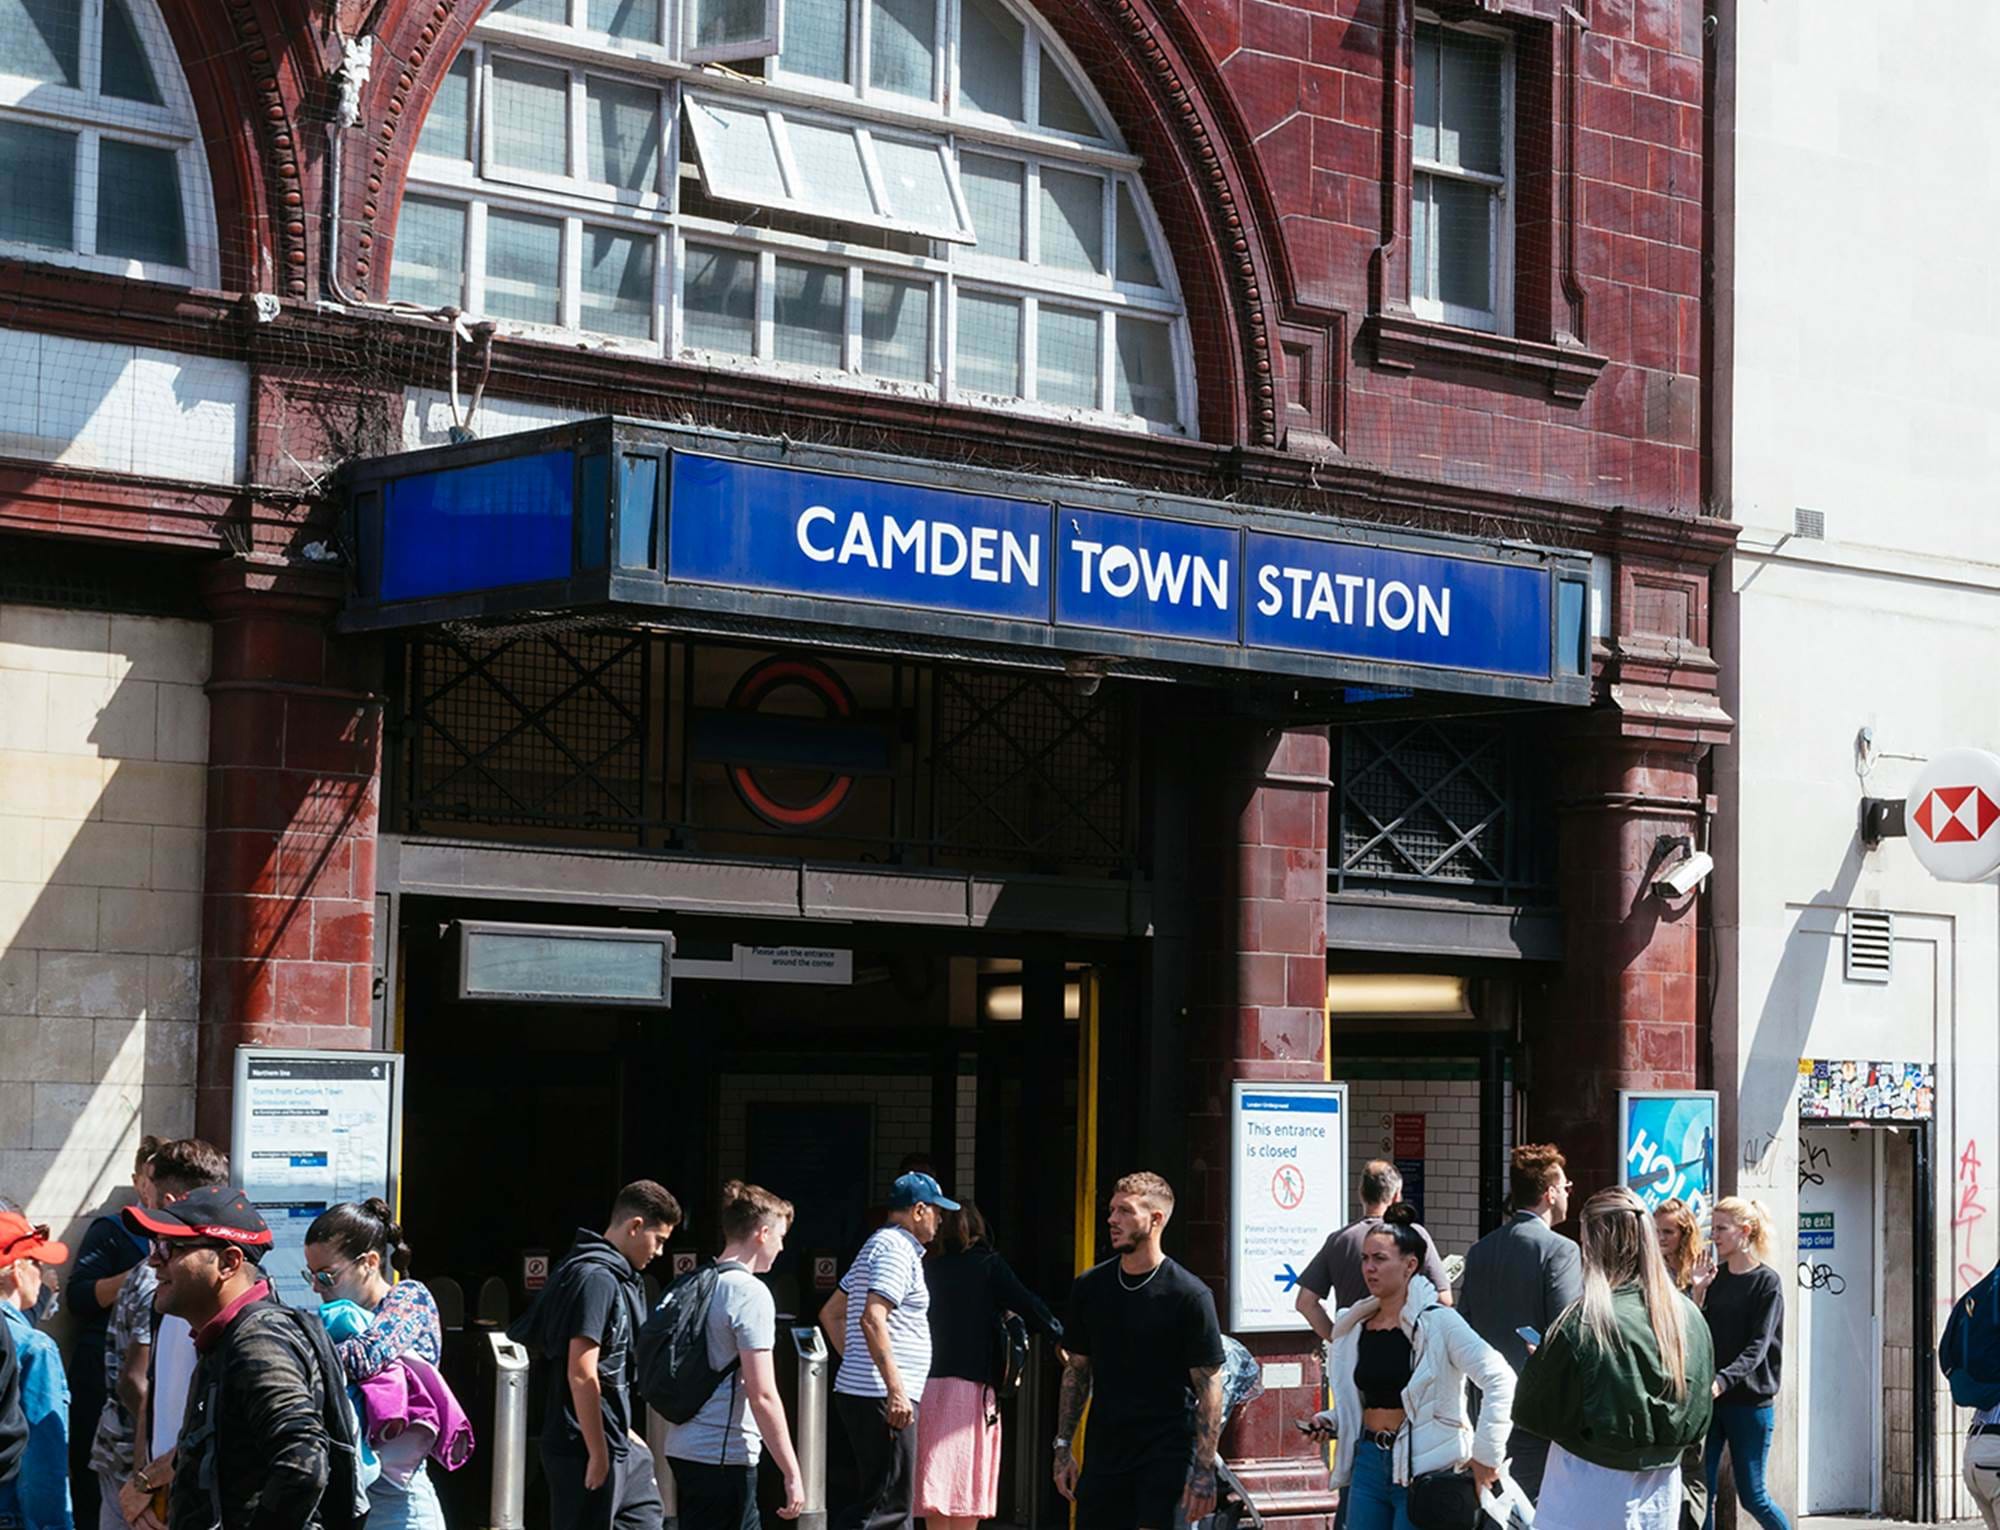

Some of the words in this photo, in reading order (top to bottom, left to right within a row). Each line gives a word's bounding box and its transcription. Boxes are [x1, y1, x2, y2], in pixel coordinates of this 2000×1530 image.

[796, 505, 1040, 588] CAMDEN
[1071, 540, 1229, 611] TOWN
[1256, 564, 1451, 637] STATION
[790, 949, 802, 957] the
[803, 949, 834, 958] entrance
[772, 959, 797, 967] around
[798, 959, 809, 967] the
[811, 959, 834, 968] corner
[1247, 1121, 1272, 1137] This
[1274, 1124, 1326, 1139] entrance
[1246, 1143, 1257, 1158] is
[1259, 1144, 1298, 1159] closed
[1626, 1128, 1708, 1226] HOLD
[1798, 1215, 1812, 1228] ire
[1813, 1215, 1832, 1228] exit
[1814, 1235, 1833, 1246] clear
